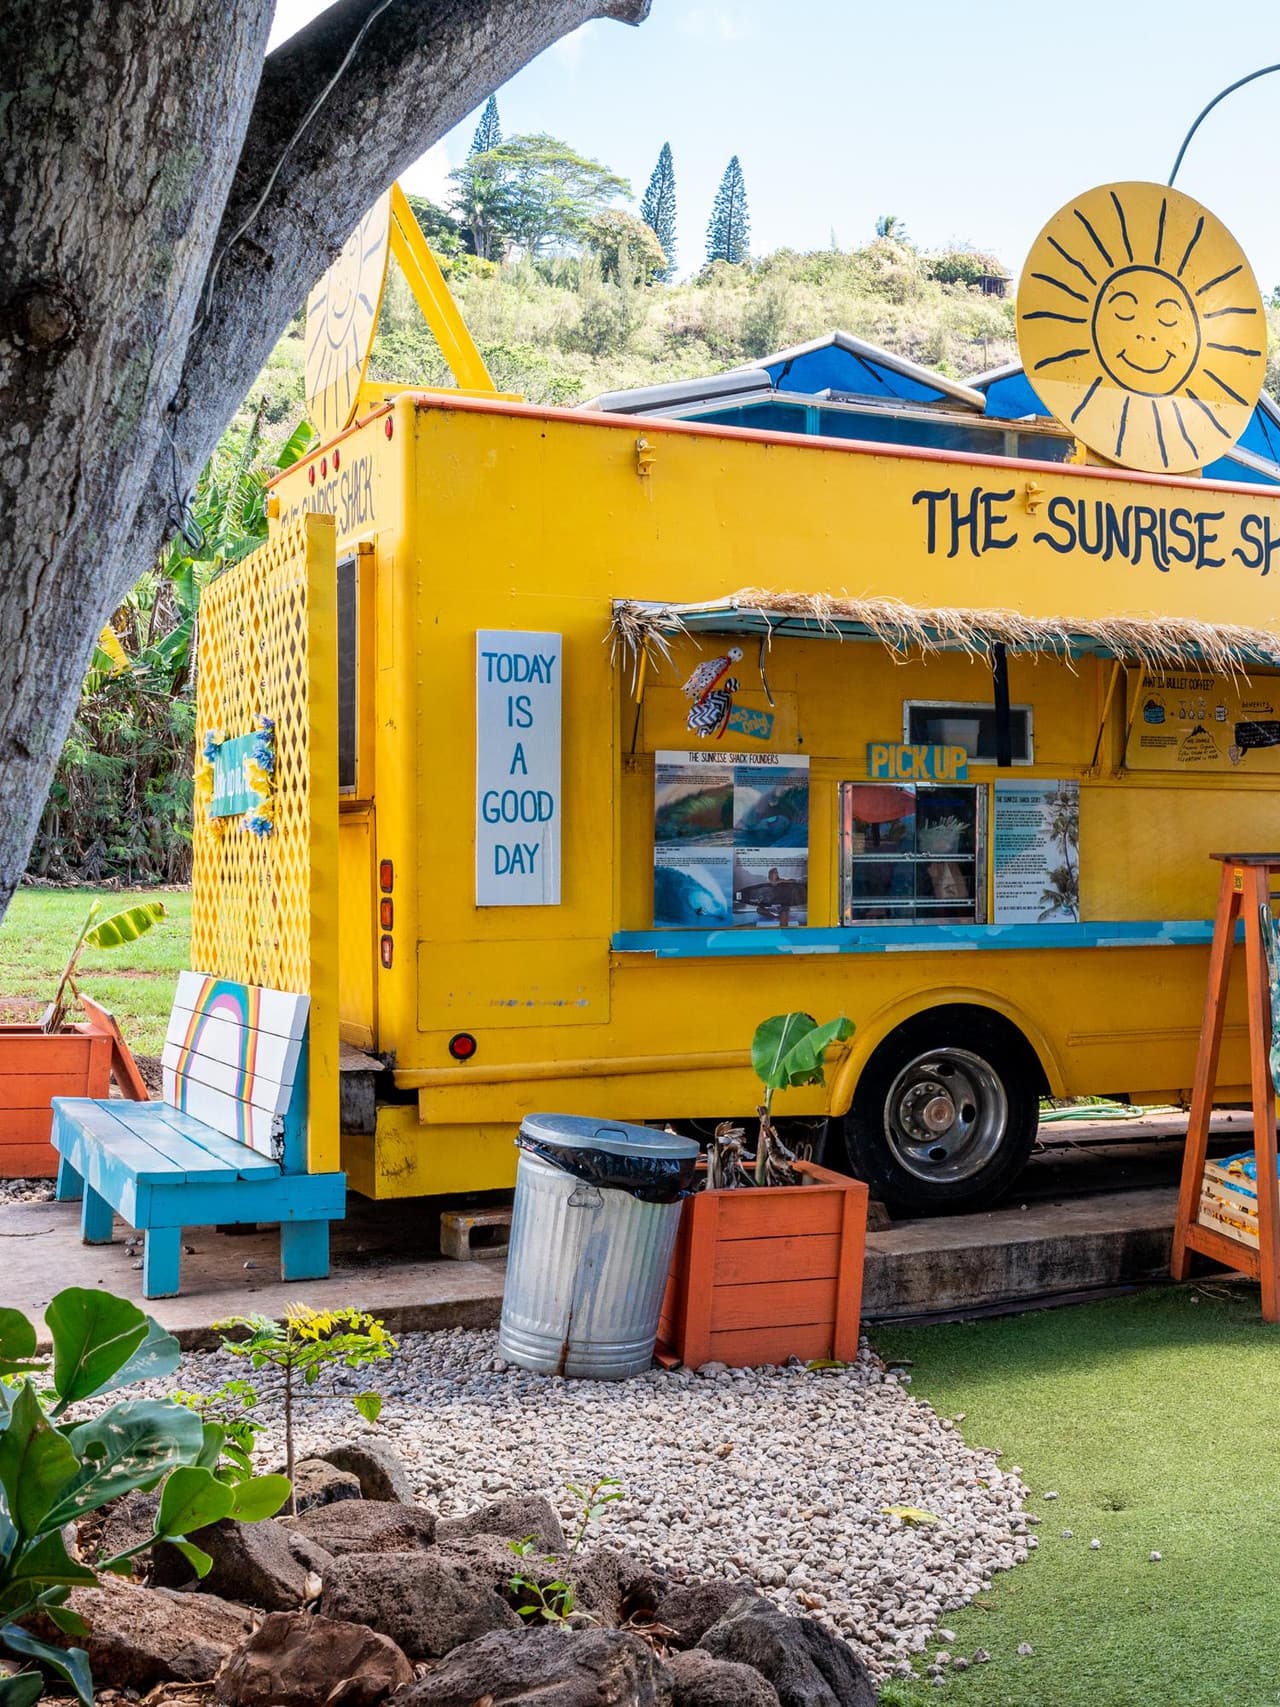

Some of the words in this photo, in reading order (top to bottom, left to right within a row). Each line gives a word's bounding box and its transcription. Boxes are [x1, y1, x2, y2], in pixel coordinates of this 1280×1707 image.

[340, 455, 375, 535] SHACK
[912, 486, 1018, 558] THE
[1033, 496, 1226, 572] SUNRISE
[481, 652, 556, 684] TODAY
[1166, 677, 1188, 690] BULLET
[1188, 679, 1215, 691] COFFEE?
[507, 695, 534, 728] IS
[509, 742, 528, 775] A
[688, 751, 699, 762] THE
[701, 752, 728, 763] SUNRISE
[729, 753, 747, 764] SHACK
[749, 754, 779, 765] FOUNDERS
[872, 745, 931, 778] PICK
[934, 746, 967, 778] UP
[482, 790, 554, 823] GOOD
[495, 843, 539, 875] DAY
